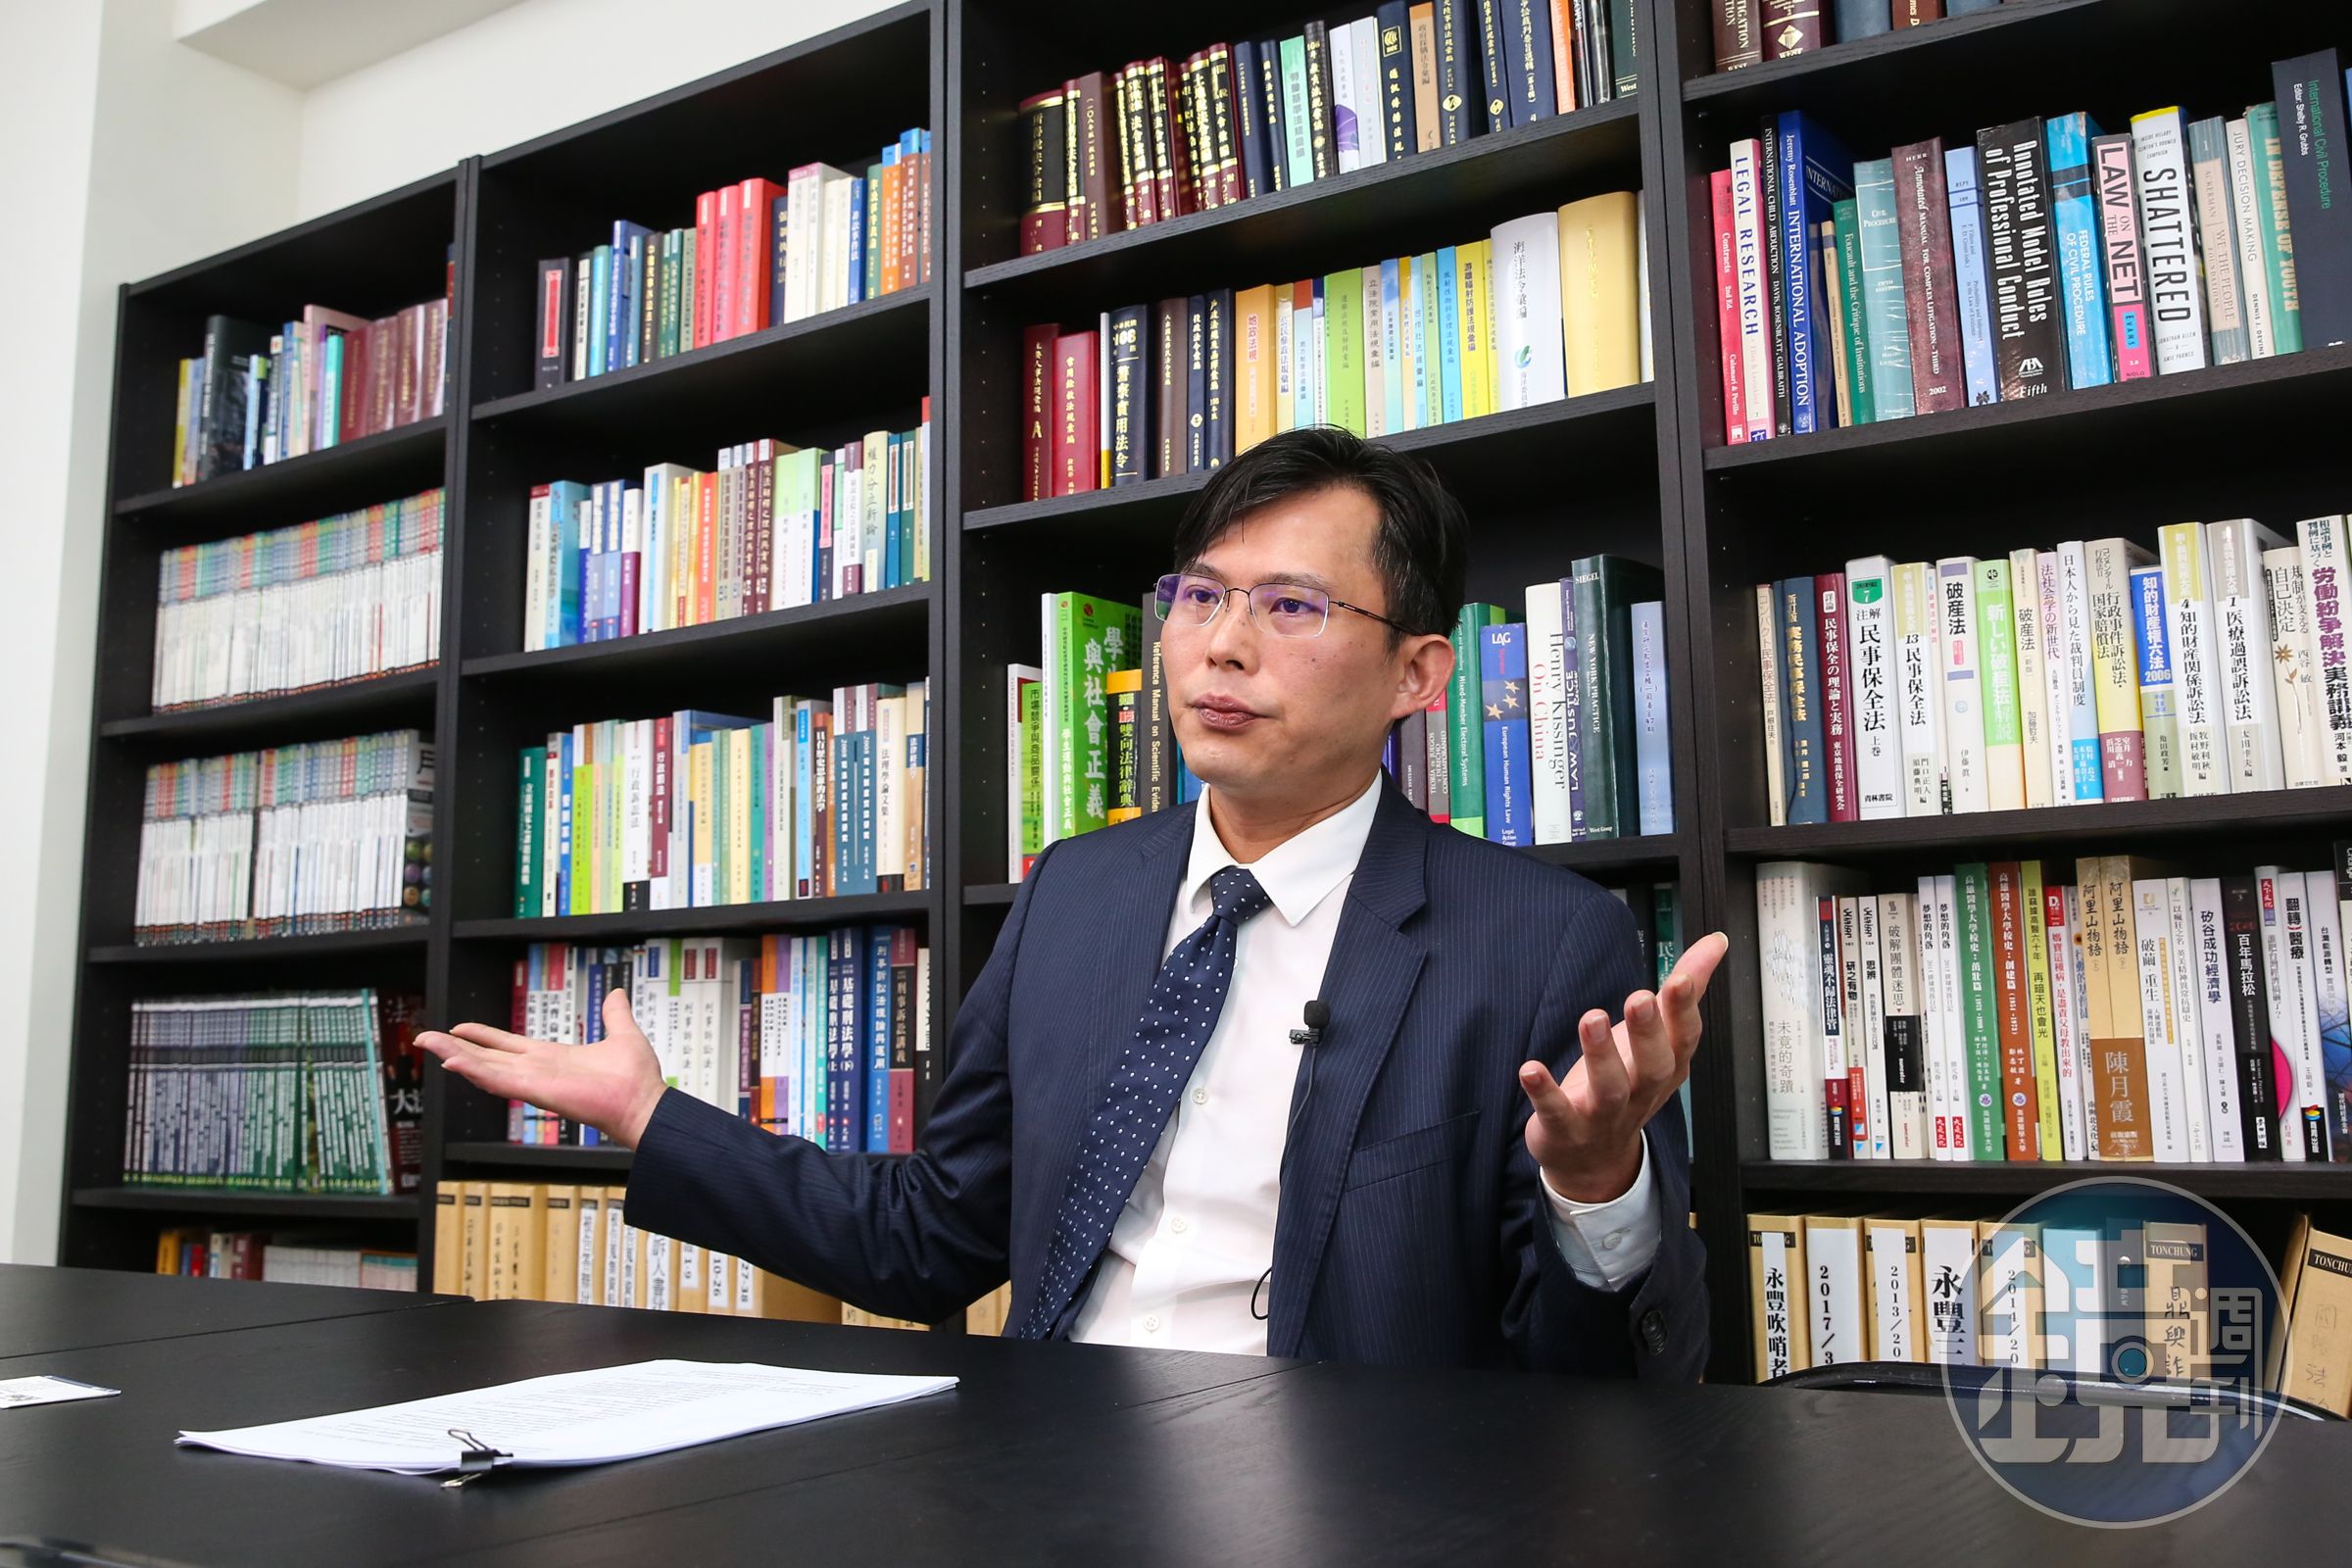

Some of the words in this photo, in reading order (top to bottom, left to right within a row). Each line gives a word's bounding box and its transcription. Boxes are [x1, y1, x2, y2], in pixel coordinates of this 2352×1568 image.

[2294, 83, 2303, 103] Editor:
[2299, 133, 2308, 156] Grubbs
[2308, 80, 2323, 136] International
[1786, 134, 1794, 163] Jeremy
[2146, 150, 2168, 159] CAMPAIGN
[2155, 130, 2172, 139] HILLARY
[2233, 132, 2245, 156] JURY
[2315, 137, 2327, 159] Civil
[1765, 128, 1775, 195] INTERNATIONAL
[1984, 149, 2011, 165] of
[2100, 147, 2130, 208] LAW
[1736, 157, 1751, 219] LEGAL
[1788, 165, 1797, 206] Rosenblatt
[1914, 166, 1930, 210] Annotated
[2014, 140, 2044, 222] Annotated
[2205, 171, 2217, 218] ACKERMAN
[2236, 161, 2250, 213] DECISION
[2317, 161, 2330, 210] Procedure
[1918, 213, 1930, 245] MANUAL
[1987, 172, 2021, 270] Professional
[2067, 233, 2076, 246] OF
[2107, 215, 2118, 236] THE
[2120, 216, 2131, 231] ON
[2217, 229, 2226, 246] WE
[2243, 219, 2257, 262] MAKING
[1722, 232, 1731, 273] Contracts
[1769, 225, 1779, 273] ABDUCTION
[1844, 233, 1855, 264] Foucault
[2021, 225, 2049, 273] Model
[2069, 249, 2079, 274] CIVIL
[2079, 229, 2090, 271] FEDERAL
[2143, 169, 2190, 322] SHATTERED
[2219, 252, 2230, 274] THE
[1740, 229, 1758, 335] RESEARCH
[1788, 210, 1805, 327] INTERNATIONAL
[1924, 267, 1933, 301] COMPLEX
[2083, 272, 2094, 302] RULES
[2110, 240, 2138, 296] NET
[2207, 248, 2219, 308] FOUNDATIONS
[2279, 258, 2299, 312] YOUTH
[1849, 287, 1858, 299] the
[1997, 275, 2025, 340] Conduct
[2026, 277, 2052, 323] Rules
[2072, 276, 2085, 336] PROCEDURE
[2221, 275, 2234, 320] PEOPLE
[1774, 306, 1784, 355] ROSENBLATT,
[1850, 301, 1860, 337] Critique
[1927, 303, 1936, 343] LITIGATION
[2126, 315, 2134, 346] EVANS
[2159, 334, 2180, 343] JONATHAN
[1776, 357, 1785, 398] GALBRAITH
[1794, 331, 1809, 406] ADOPTION
[1855, 346, 1866, 393] Institutions
[1931, 351, 1939, 374] THIRD
[1929, 386, 1946, 395] 2002
[2020, 383, 2047, 398] Fifth
[2308, 521, 2321, 567] 判例に基づく
[2320, 519, 2332, 559] 相談事例と
[1575, 572, 1599, 584] SIEGEL
[1863, 590, 1871, 603] 7
[2274, 566, 2295, 633] 自己決定
[1856, 609, 1882, 622] 注解
[1945, 582, 1967, 636] 破産法
[2040, 564, 2060, 660] 法社会学の新世代
[2142, 576, 2165, 669] 知的財産権六法
[2180, 598, 2190, 610] 4
[2230, 597, 2236, 608] 1
[1492, 632, 1511, 646] LAG
[1905, 634, 1919, 645] 13
[2018, 608, 2036, 652] 破産法
[2064, 555, 2086, 707] 日本人から見た裁判員制度
[2092, 593, 2110, 660] 国家賠償法
[2312, 566, 2350, 731] 労働紛争解決実務講義
[1152, 641, 1161, 685] Reference
[1549, 633, 1564, 693] Henry
[1590, 657, 1599, 684] YORK
[1758, 595, 1776, 704] コンパクト民事保全法
[2179, 612, 2206, 724] 知的財産関係訴訟法
[2226, 610, 2253, 721] 医療過誤訴訟法
[2297, 650, 2310, 667] 西谷
[1532, 663, 1546, 693] On
[1824, 617, 1843, 736] 民事保全の理論と実務
[1859, 624, 1886, 732] 民事保全法
[1905, 647, 1927, 726] 民事保全法
[2144, 670, 2172, 682] 2006
[1152, 689, 1160, 721] Manual
[1566, 670, 1577, 738] JUSTICE
[1591, 685, 1600, 734] PRACTICE
[1083, 637, 1106, 820] 與社會正義
[1152, 726, 1158, 737] on
[1534, 702, 1549, 760] China
[1548, 701, 1566, 786] Kissinger
[1871, 737, 1882, 757] 上巻
[2028, 710, 2038, 745] 加藤哲夫
[2334, 733, 2346, 750] 河本
[1152, 740, 1160, 782] Scientific
[1570, 752, 1579, 791] LAW
[2199, 732, 2211, 769] 牧野利秋
[1864, 792, 1893, 804] 青林書院
[1921, 758, 1931, 795] 門口正人
[1923, 904, 1933, 950] 夢想的角落
[1939, 904, 1950, 949] 夢想的角落
[2083, 884, 2102, 956] 阿里山物語
[2110, 882, 2129, 955] 阿里山物語
[2173, 905, 2184, 945] 以瘋狂之名
[1866, 960, 1876, 980] 思辨
[1888, 925, 1904, 1005] 破解團體迷思
[2200, 910, 2221, 1004] 矽谷成功經濟學
[2237, 934, 2255, 996] 百年馬拉松
[1822, 954, 1838, 1035] 靈魂不歸法律管
[1846, 961, 1857, 1001] 研之有物
[2177, 950, 2191, 1022] 英美精神異常抗辯史
[2033, 972, 2049, 1039] 再暗天也會光
[1778, 1020, 1793, 1094] 未竟的奇蹟
[2106, 1051, 2133, 1124] 陳月霞
[2150, 1245, 2197, 1257] TONCHUNG
[1765, 1267, 1788, 1379] 永豐吹哨者
